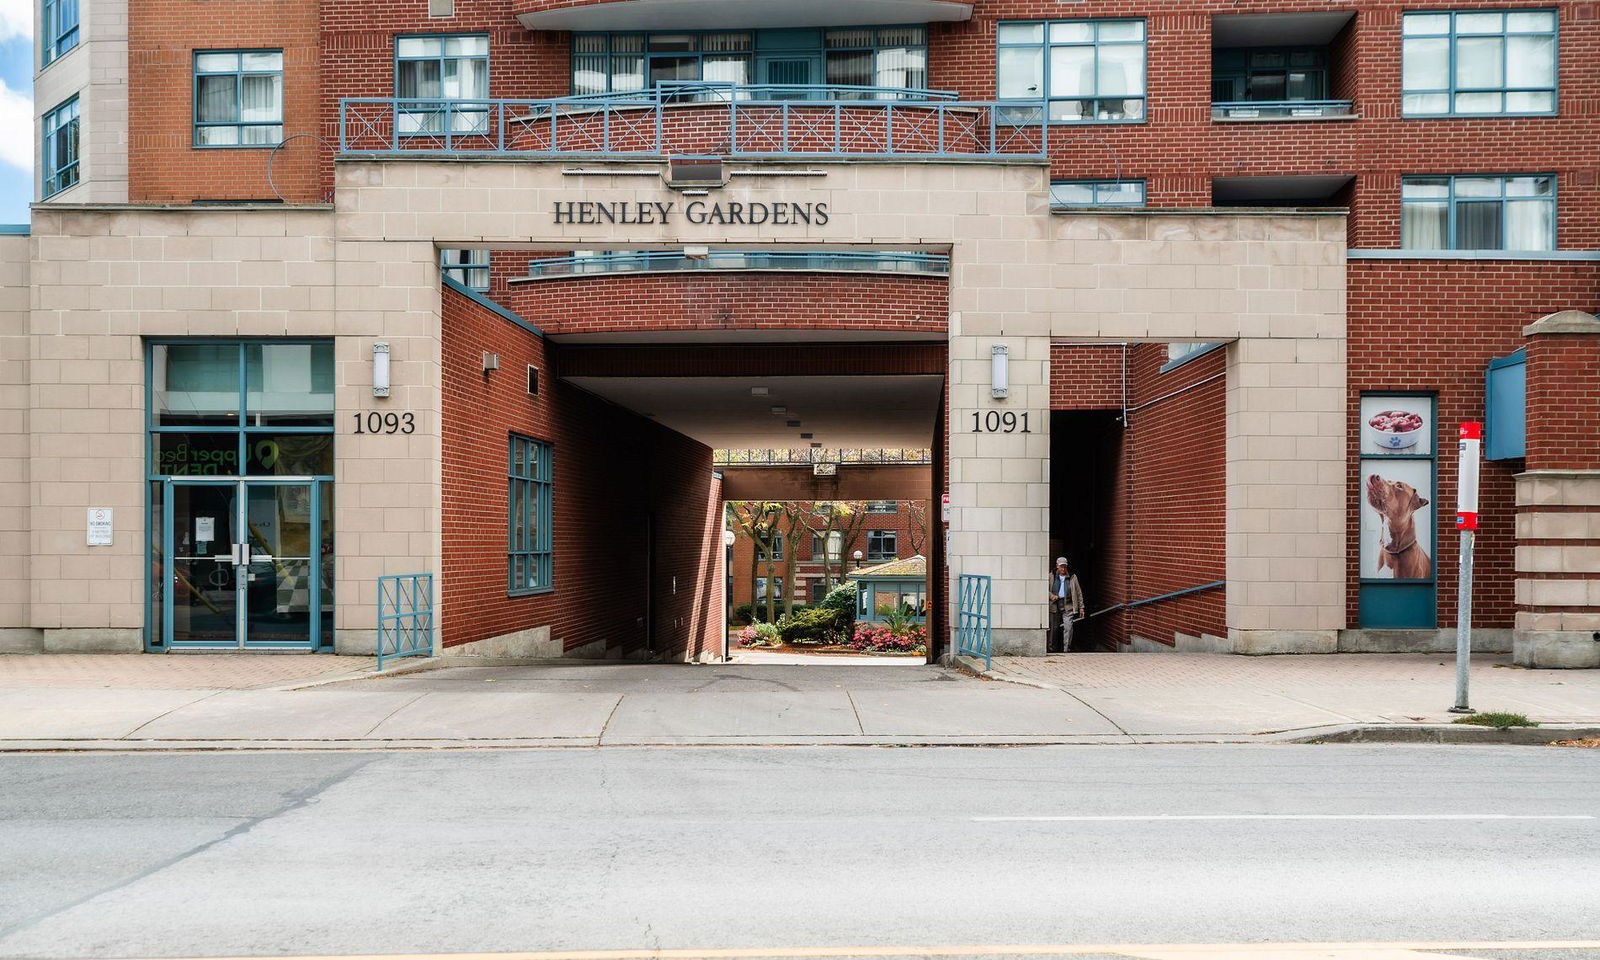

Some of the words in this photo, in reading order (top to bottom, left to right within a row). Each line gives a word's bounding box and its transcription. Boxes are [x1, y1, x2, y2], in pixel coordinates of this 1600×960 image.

[553, 201, 674, 225] HENLEY
[685, 200, 829, 226] GARDENS
[353, 411, 415, 434] 1093
[971, 410, 1031, 433] 1091
